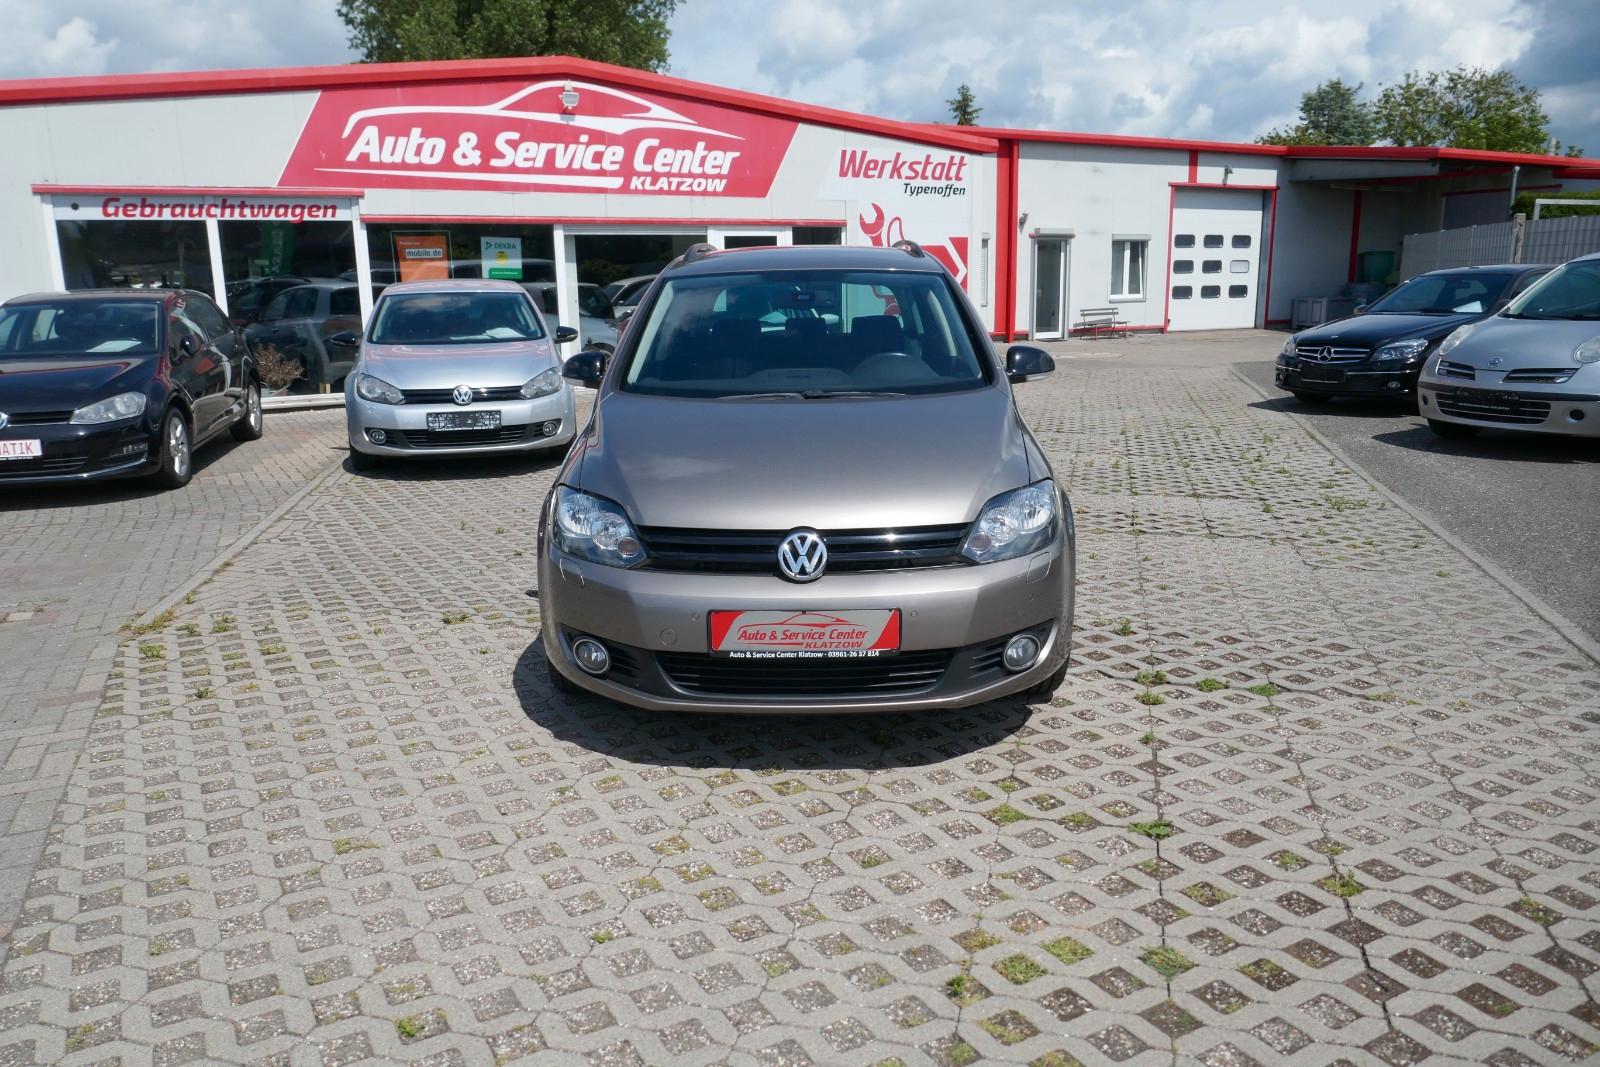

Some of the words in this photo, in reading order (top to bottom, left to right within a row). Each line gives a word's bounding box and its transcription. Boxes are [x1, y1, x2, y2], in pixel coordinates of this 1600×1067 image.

[345, 125, 445, 165] Auto
[453, 132, 482, 166] &
[490, 132, 624, 171] Service
[633, 138, 741, 175] Center
[838, 149, 967, 182] Werkstatt
[629, 176, 727, 193] KLATZOW
[903, 182, 966, 198] Typenoffen
[102, 196, 338, 224] Gebrauchtwagen
[406, 248, 442, 257] mobile.de
[494, 242, 517, 250] DEKRA
[0, 442, 34, 456] ATIK
[738, 629, 766, 641] Auto
[769, 630, 778, 641] &
[781, 629, 825, 641] Service
[829, 628, 869, 640] Center
[804, 641, 864, 649] KLATZOW
